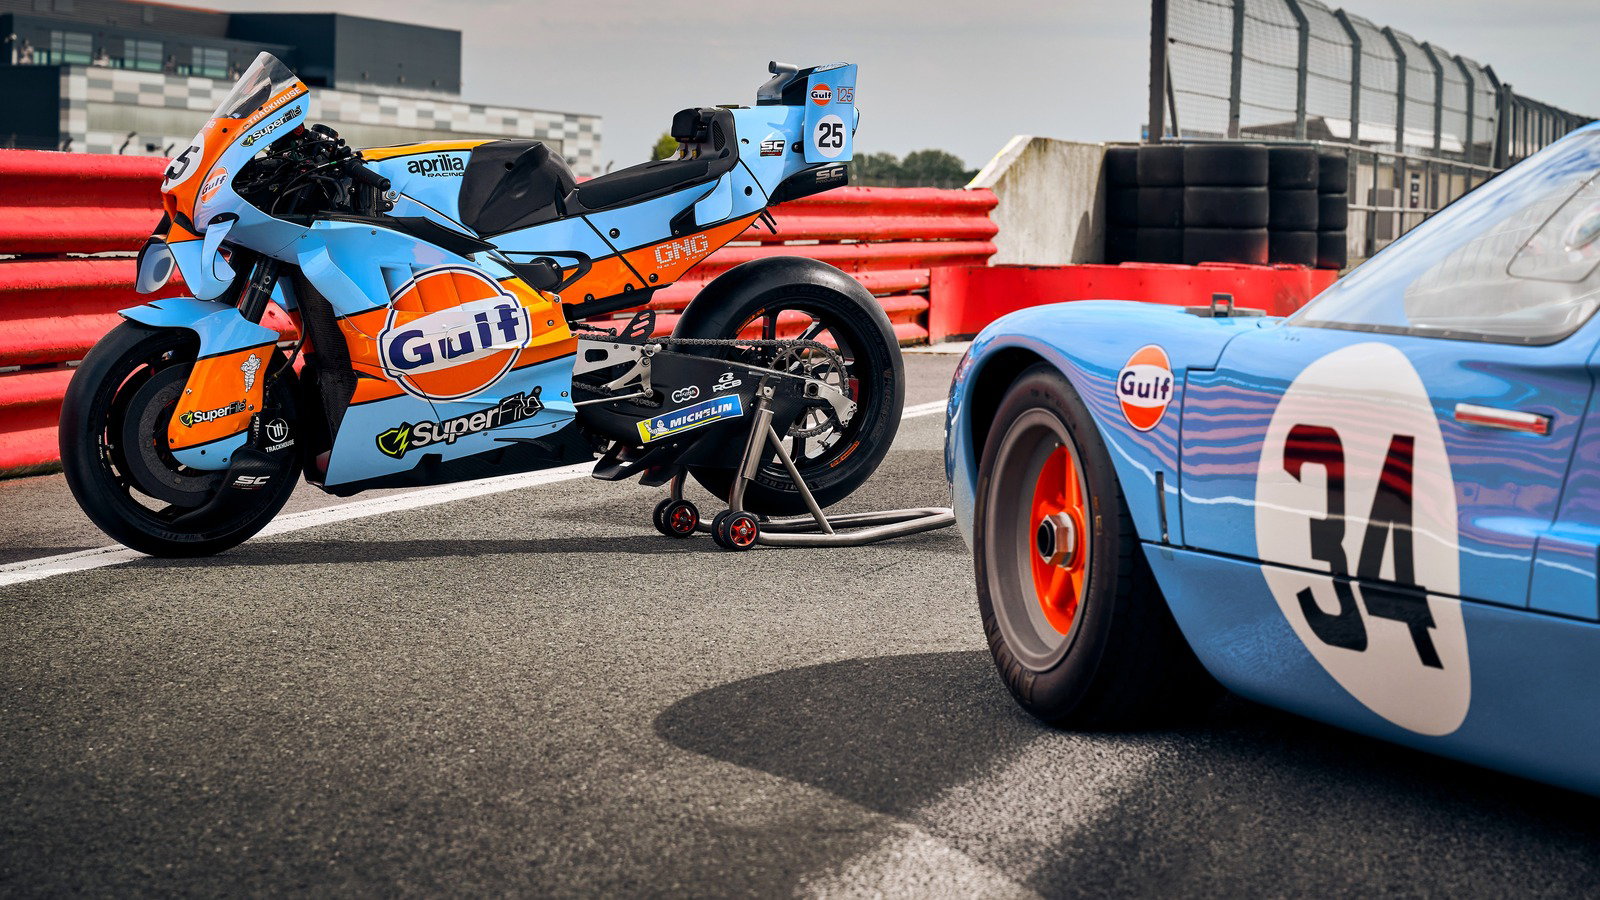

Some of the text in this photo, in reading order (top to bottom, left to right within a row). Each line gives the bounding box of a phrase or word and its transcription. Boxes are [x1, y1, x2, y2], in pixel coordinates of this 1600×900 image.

[811, 91, 832, 99] Gulf
[836, 88, 853, 102] 125
[248, 87, 302, 125] TRACKHOUSE
[761, 141, 783, 150] SC
[818, 122, 843, 148] 25
[407, 154, 465, 176] aprilia
[816, 167, 844, 180] SC
[202, 174, 227, 195] Gulf
[655, 234, 709, 264] GNG
[388, 304, 520, 370] Gulf
[712, 380, 742, 393] RCB
[1120, 371, 1171, 400] Gulf
[193, 402, 247, 423] SuperFile
[669, 403, 733, 429] MICHELIN
[265, 438, 295, 453] TRACKHOUSE
[234, 475, 271, 485] SC
[1283, 423, 1445, 670] 34
